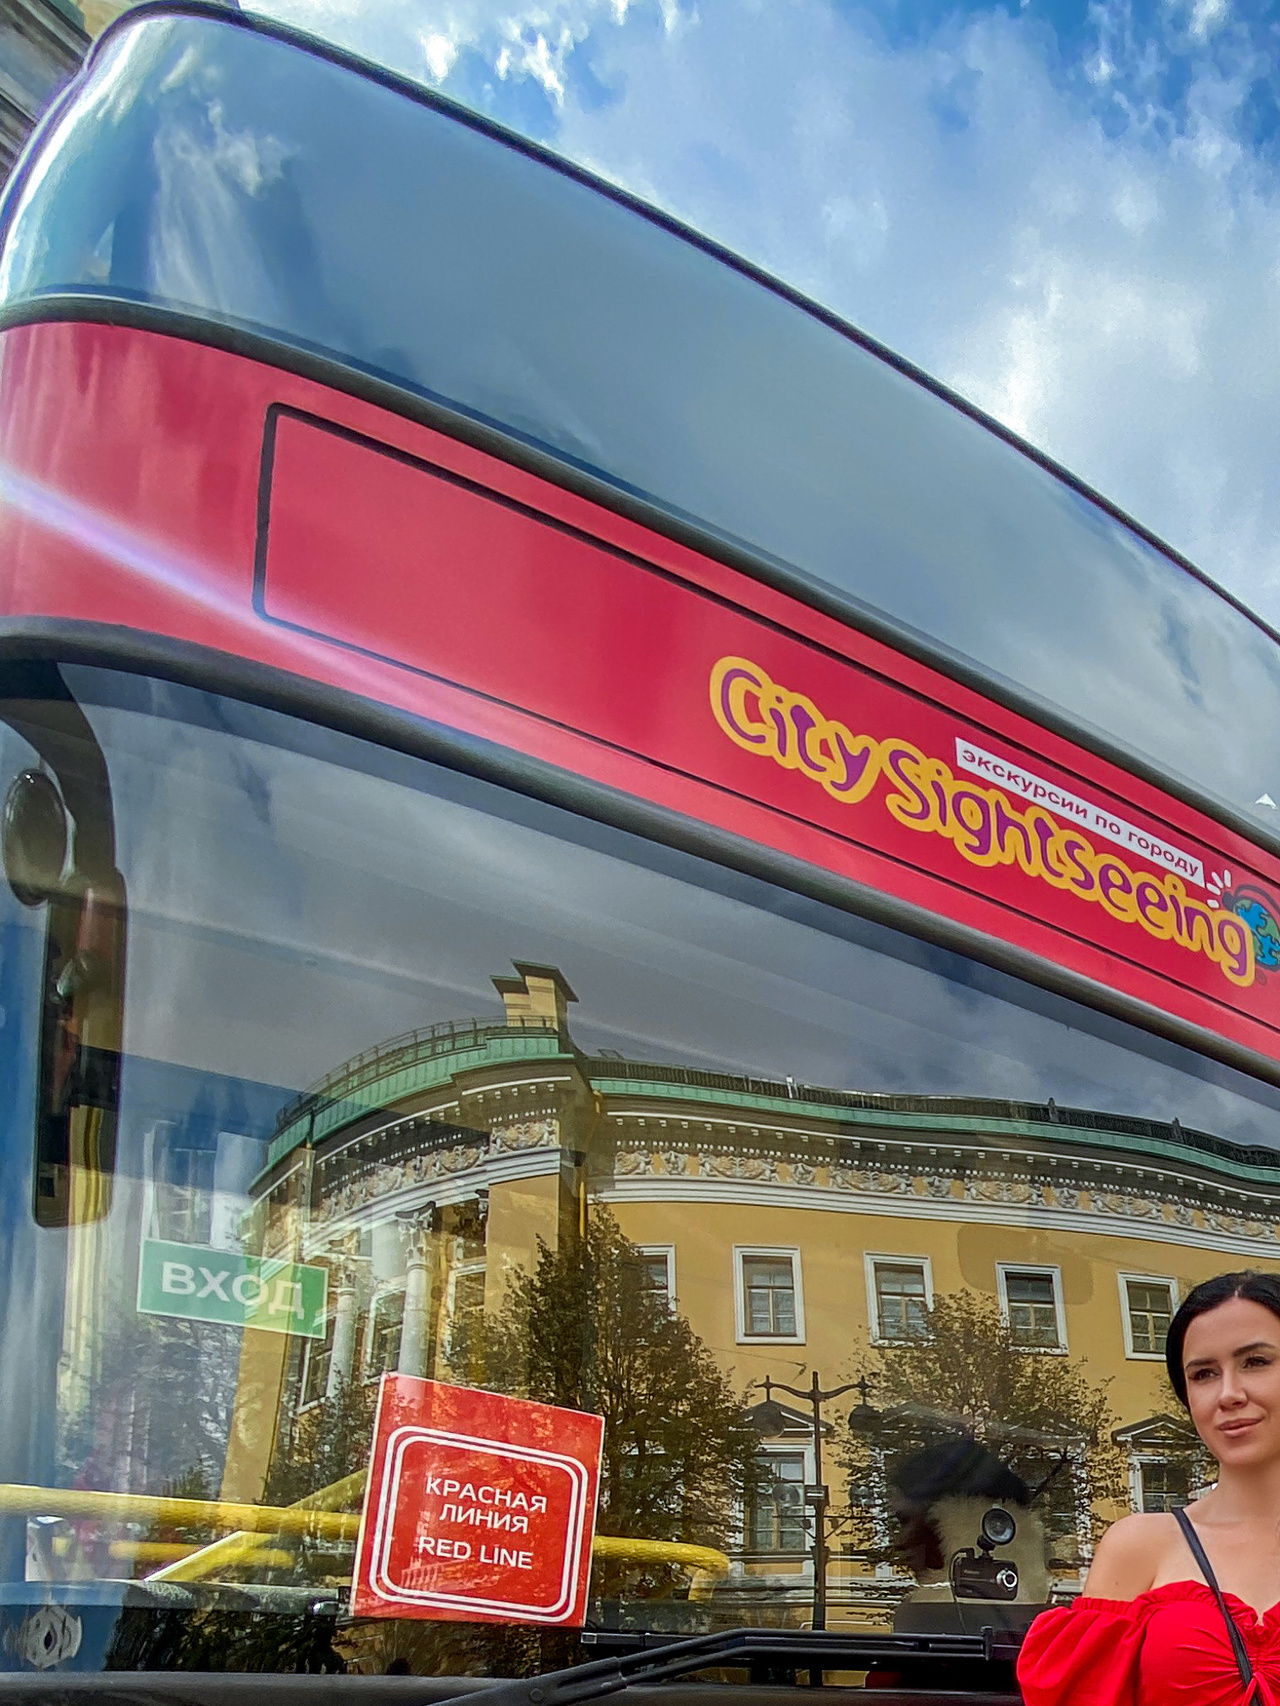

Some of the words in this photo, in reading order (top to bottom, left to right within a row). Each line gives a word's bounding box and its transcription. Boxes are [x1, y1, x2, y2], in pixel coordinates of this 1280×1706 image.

[962, 749, 1088, 818] экскурсии
[1095, 817, 1121, 835] по
[1128, 831, 1199, 877] городу
[161, 1262, 306, 1320] ВХОД
[425, 1476, 547, 1514] КРАСНАЯ
[439, 1502, 529, 1534] ЛИНИЯ
[419, 1535, 469, 1560] RED
[479, 1543, 534, 1570] LINE
